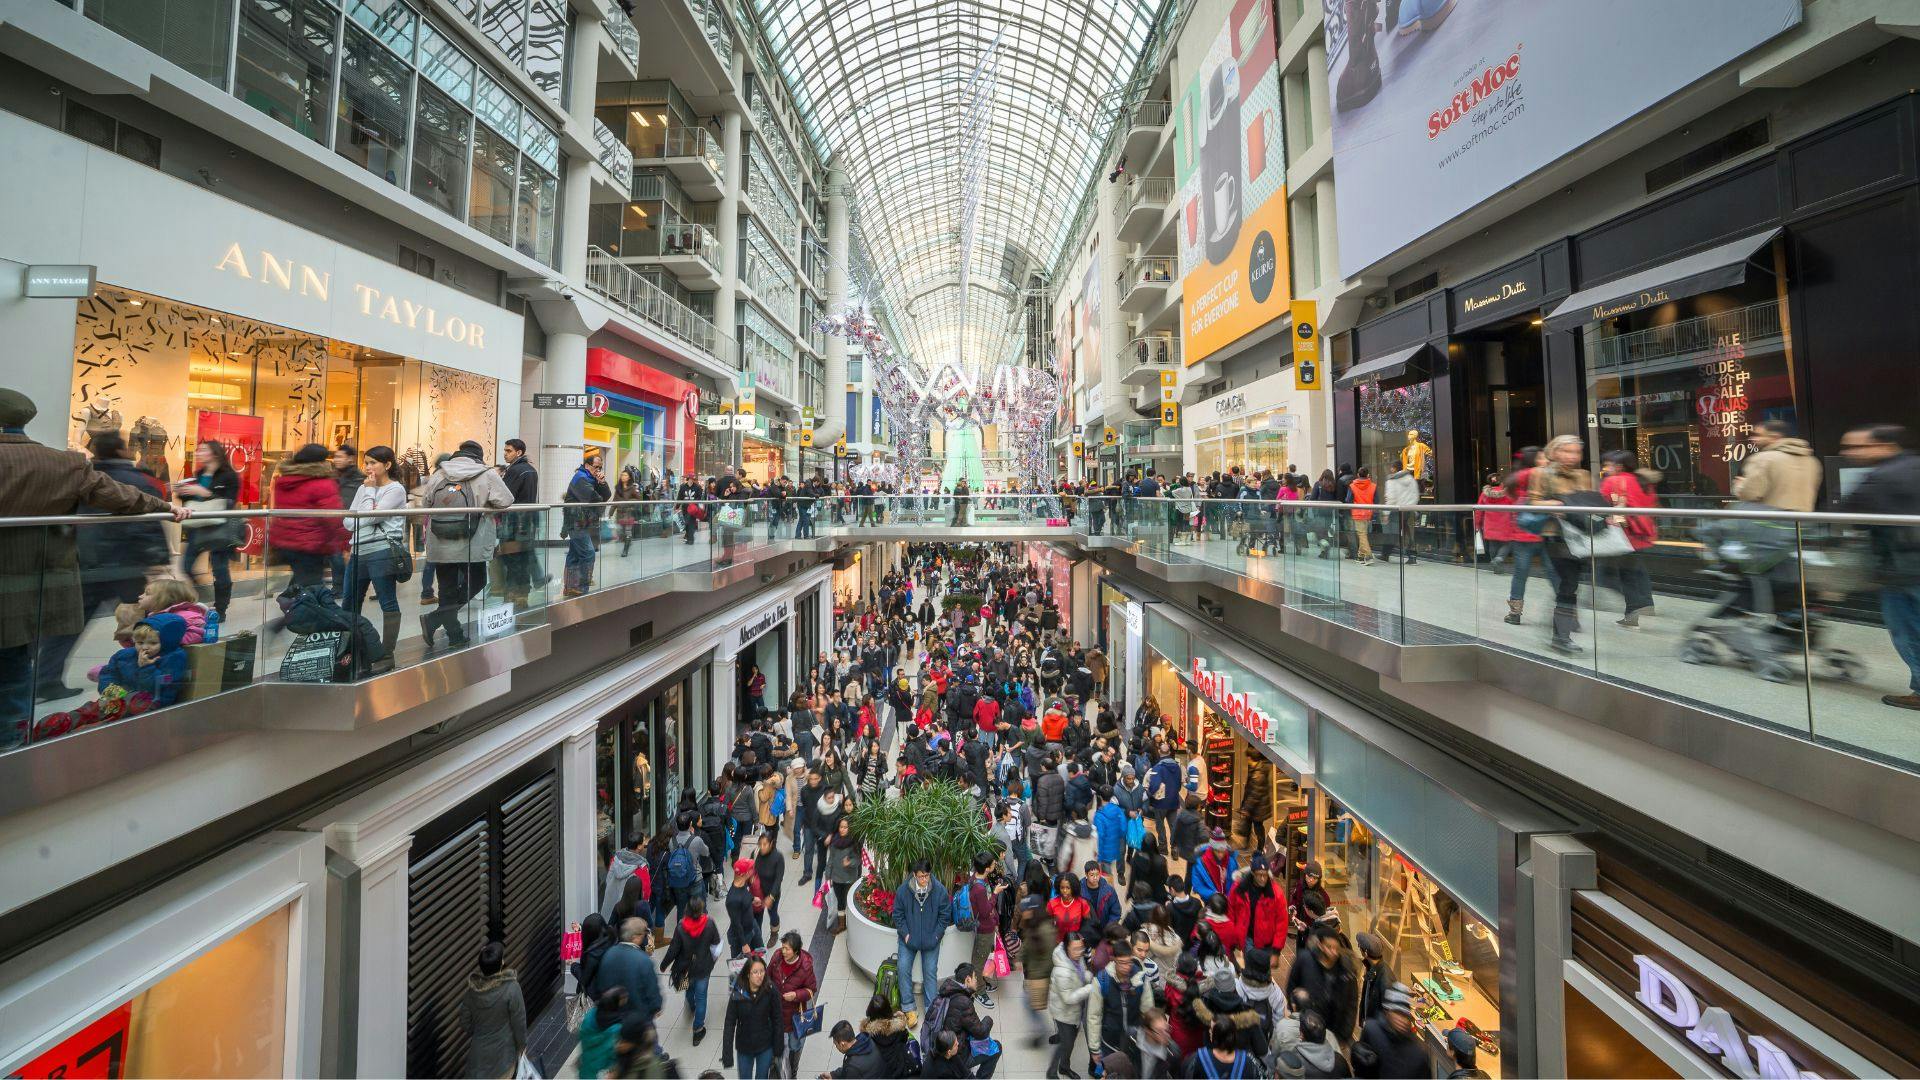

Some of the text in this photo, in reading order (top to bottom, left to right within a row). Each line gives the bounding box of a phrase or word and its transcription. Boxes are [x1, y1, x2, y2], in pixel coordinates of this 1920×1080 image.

[1438, 103, 1525, 169] www.softmoc.com
[1251, 258, 1274, 283] KEURIG
[214, 241, 486, 350] ANN TAYLOR
[1195, 281, 1223, 313] PERFECT
[1223, 270, 1239, 293] CUP
[1464, 281, 1527, 313] Massimo Dutti
[1592, 289, 1670, 321] Massimo Dutti
[1191, 290, 1240, 337] FOR EVERYONE
[1698, 360, 1743, 377] SOLDES
[1713, 384, 1745, 399] SALE
[1702, 411, 1746, 426] SOLDES
[1711, 442, 1760, 463] -50%
[739, 611, 772, 646] Abercrombie
[777, 600, 788, 622] Fitch
[1193, 656, 1277, 744] Foot Locker
